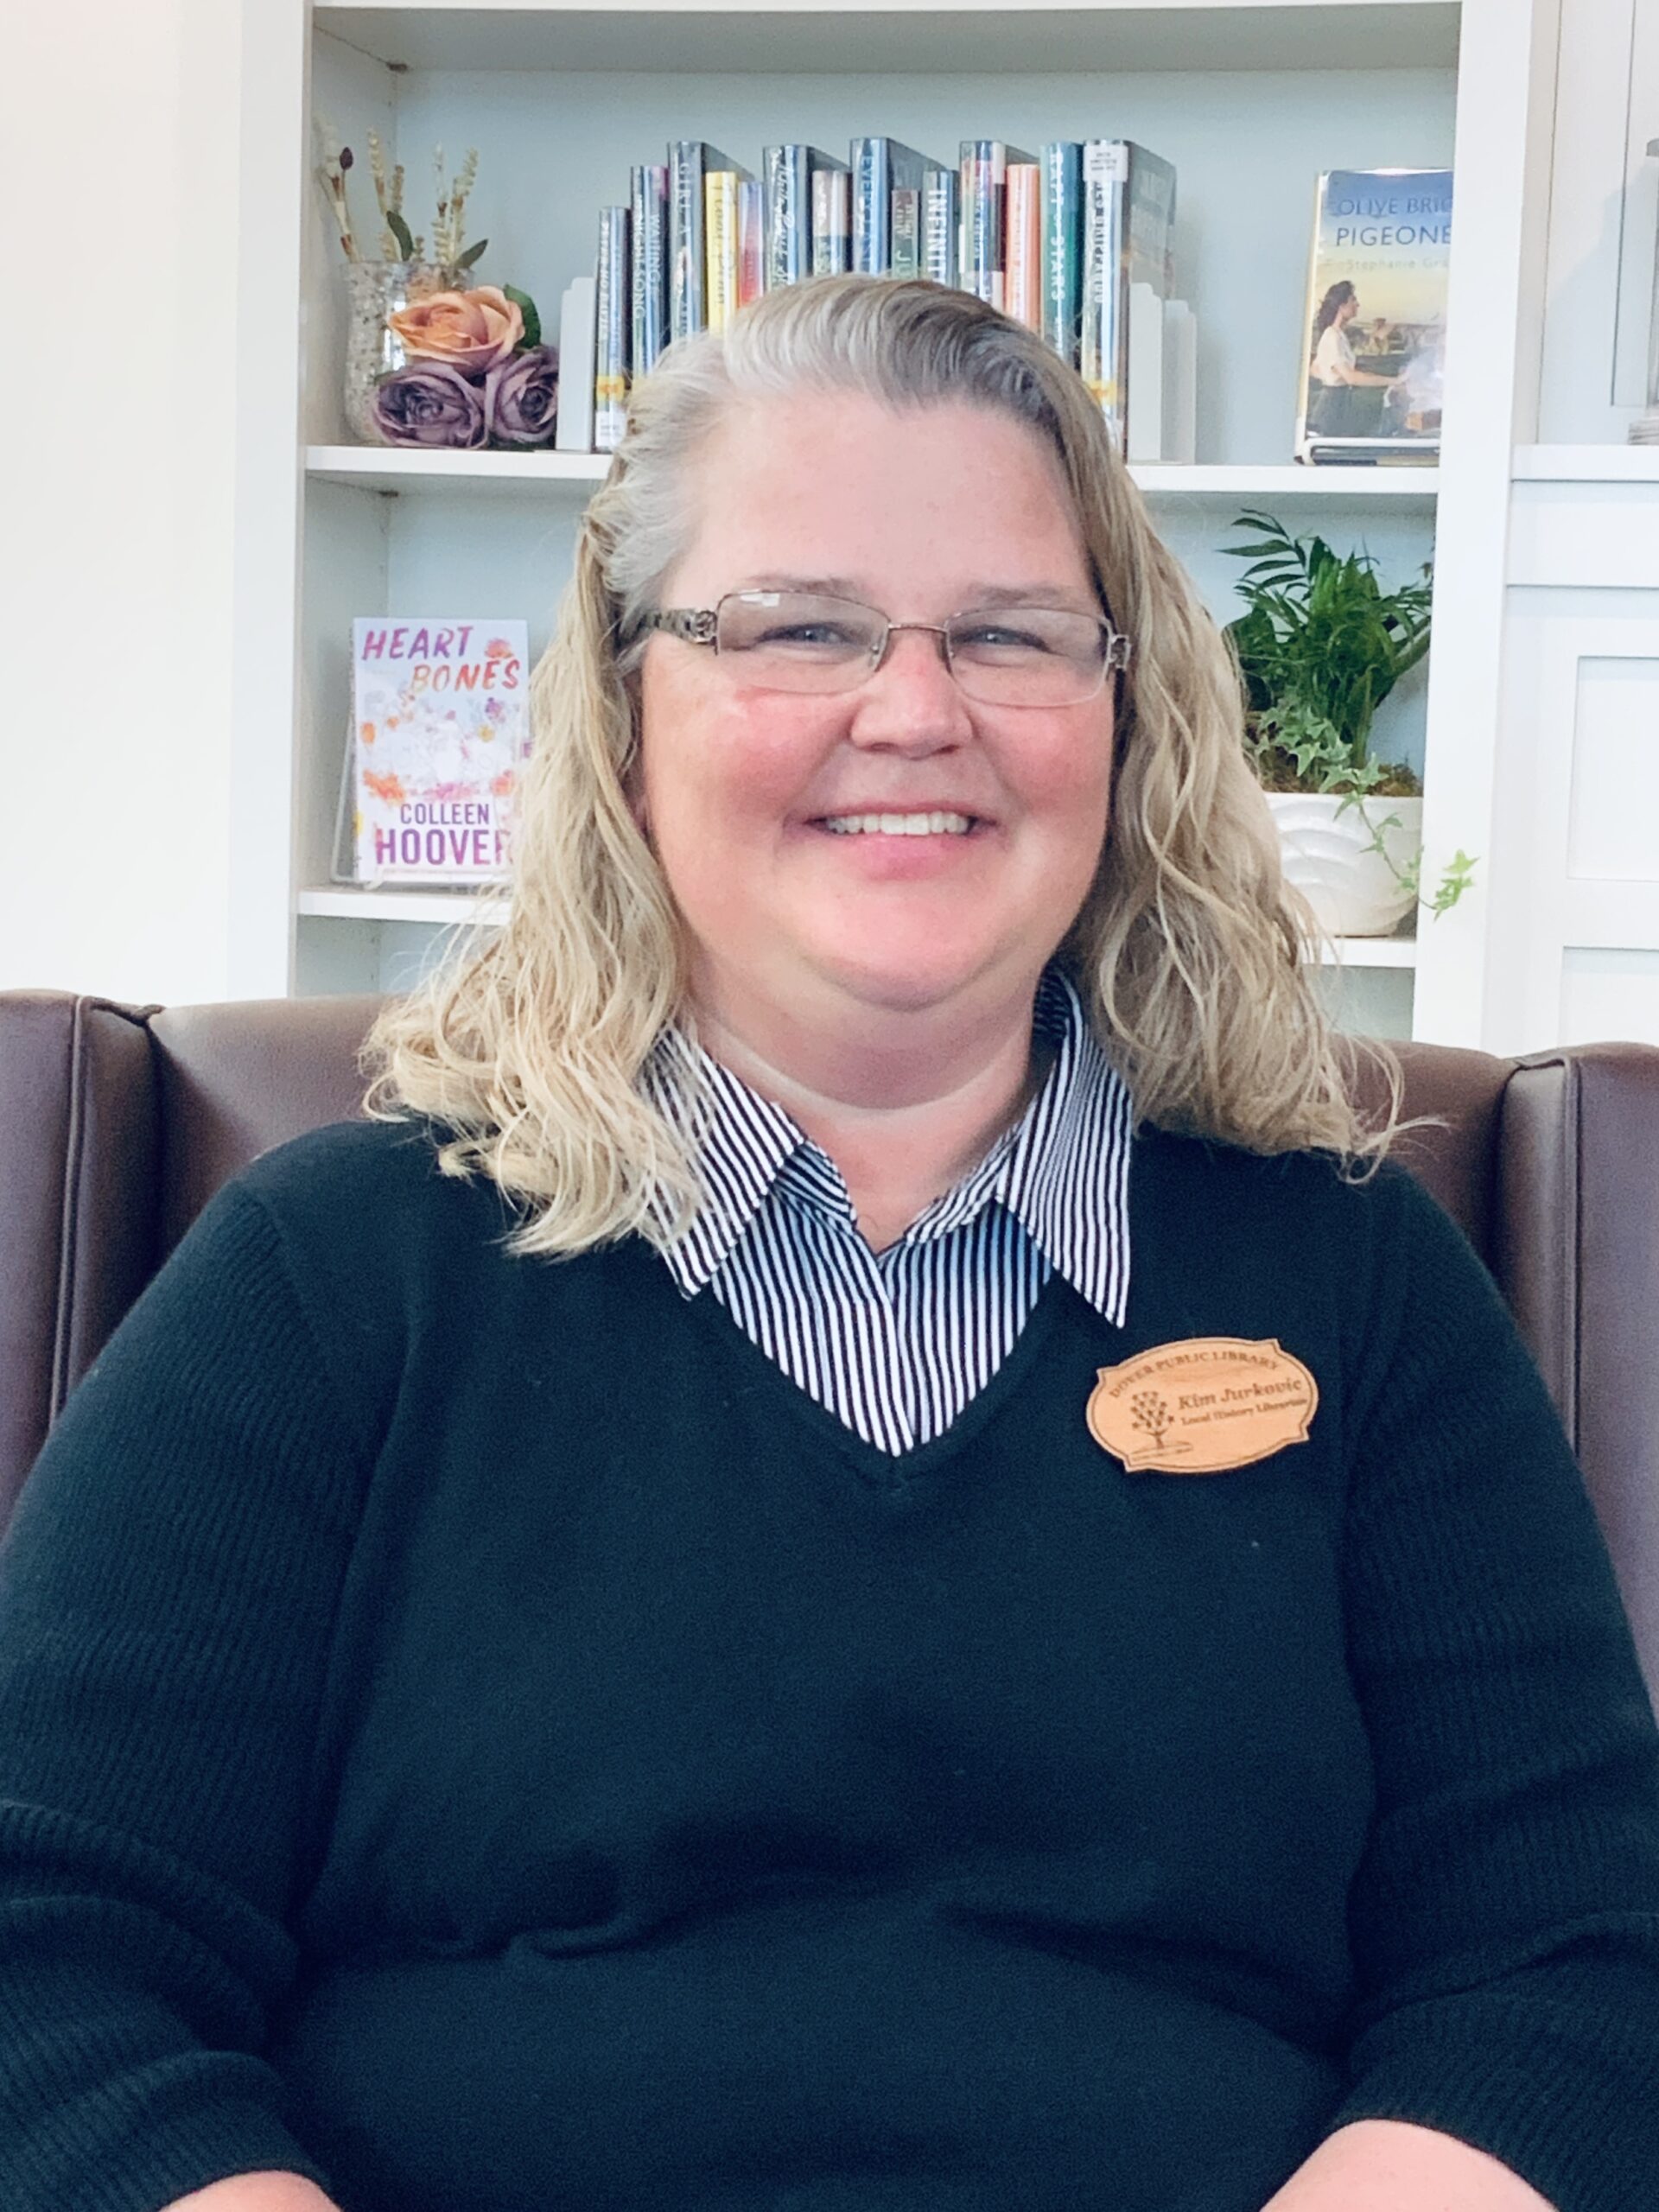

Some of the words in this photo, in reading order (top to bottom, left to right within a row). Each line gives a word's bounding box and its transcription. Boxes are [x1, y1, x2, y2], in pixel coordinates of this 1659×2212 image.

[678, 162, 691, 209] GIRL
[861, 155, 873, 209] EVERY
[1049, 152, 1065, 207] RAFT
[1338, 198, 1399, 216] OLIVE
[648, 213, 661, 282] WAITING
[1346, 258, 1416, 272] Stephanie
[1051, 236, 1065, 302] STARS
[633, 270, 646, 320] SONG
[361, 626, 474, 661] HEART
[410, 658, 520, 691] BONES
[400, 803, 490, 825] COLLEEN
[1109, 1365, 1154, 1398] DOVER
[1154, 1351, 1209, 1370] PUBLIC
[1212, 1351, 1278, 1370] LIBRARY
[1178, 1393, 1217, 1410] Kim
[1220, 1376, 1302, 1403] Jurkovic
[1180, 1412, 1211, 1426] Local
[1212, 1407, 1254, 1421] History
[1255, 1398, 1308, 1414] Librarian
